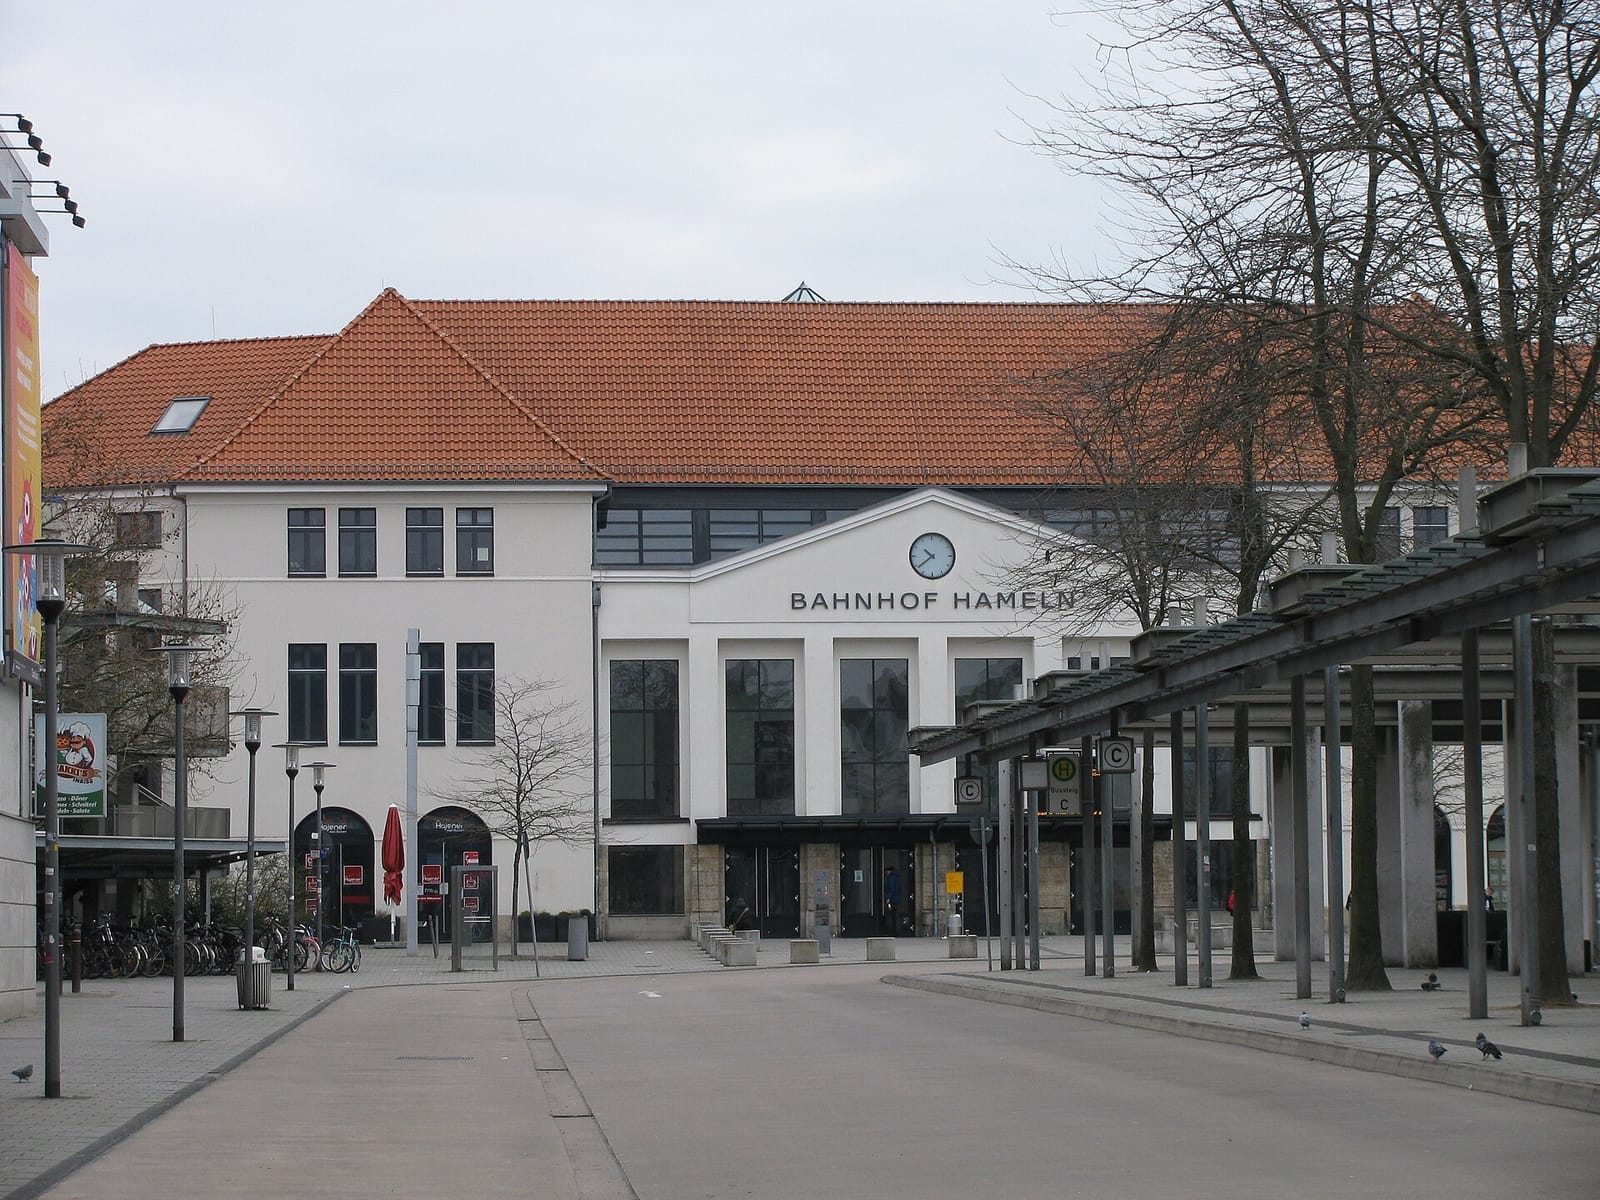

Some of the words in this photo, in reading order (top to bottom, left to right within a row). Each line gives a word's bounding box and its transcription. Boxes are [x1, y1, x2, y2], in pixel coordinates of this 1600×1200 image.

[791, 592, 938, 610] BAHNHOF
[954, 592, 1075, 609] HAMELN
[1111, 748, 1122, 763] C
[1059, 762, 1069, 777] H
[965, 784, 974, 796] C
[1060, 799, 1069, 810] C
